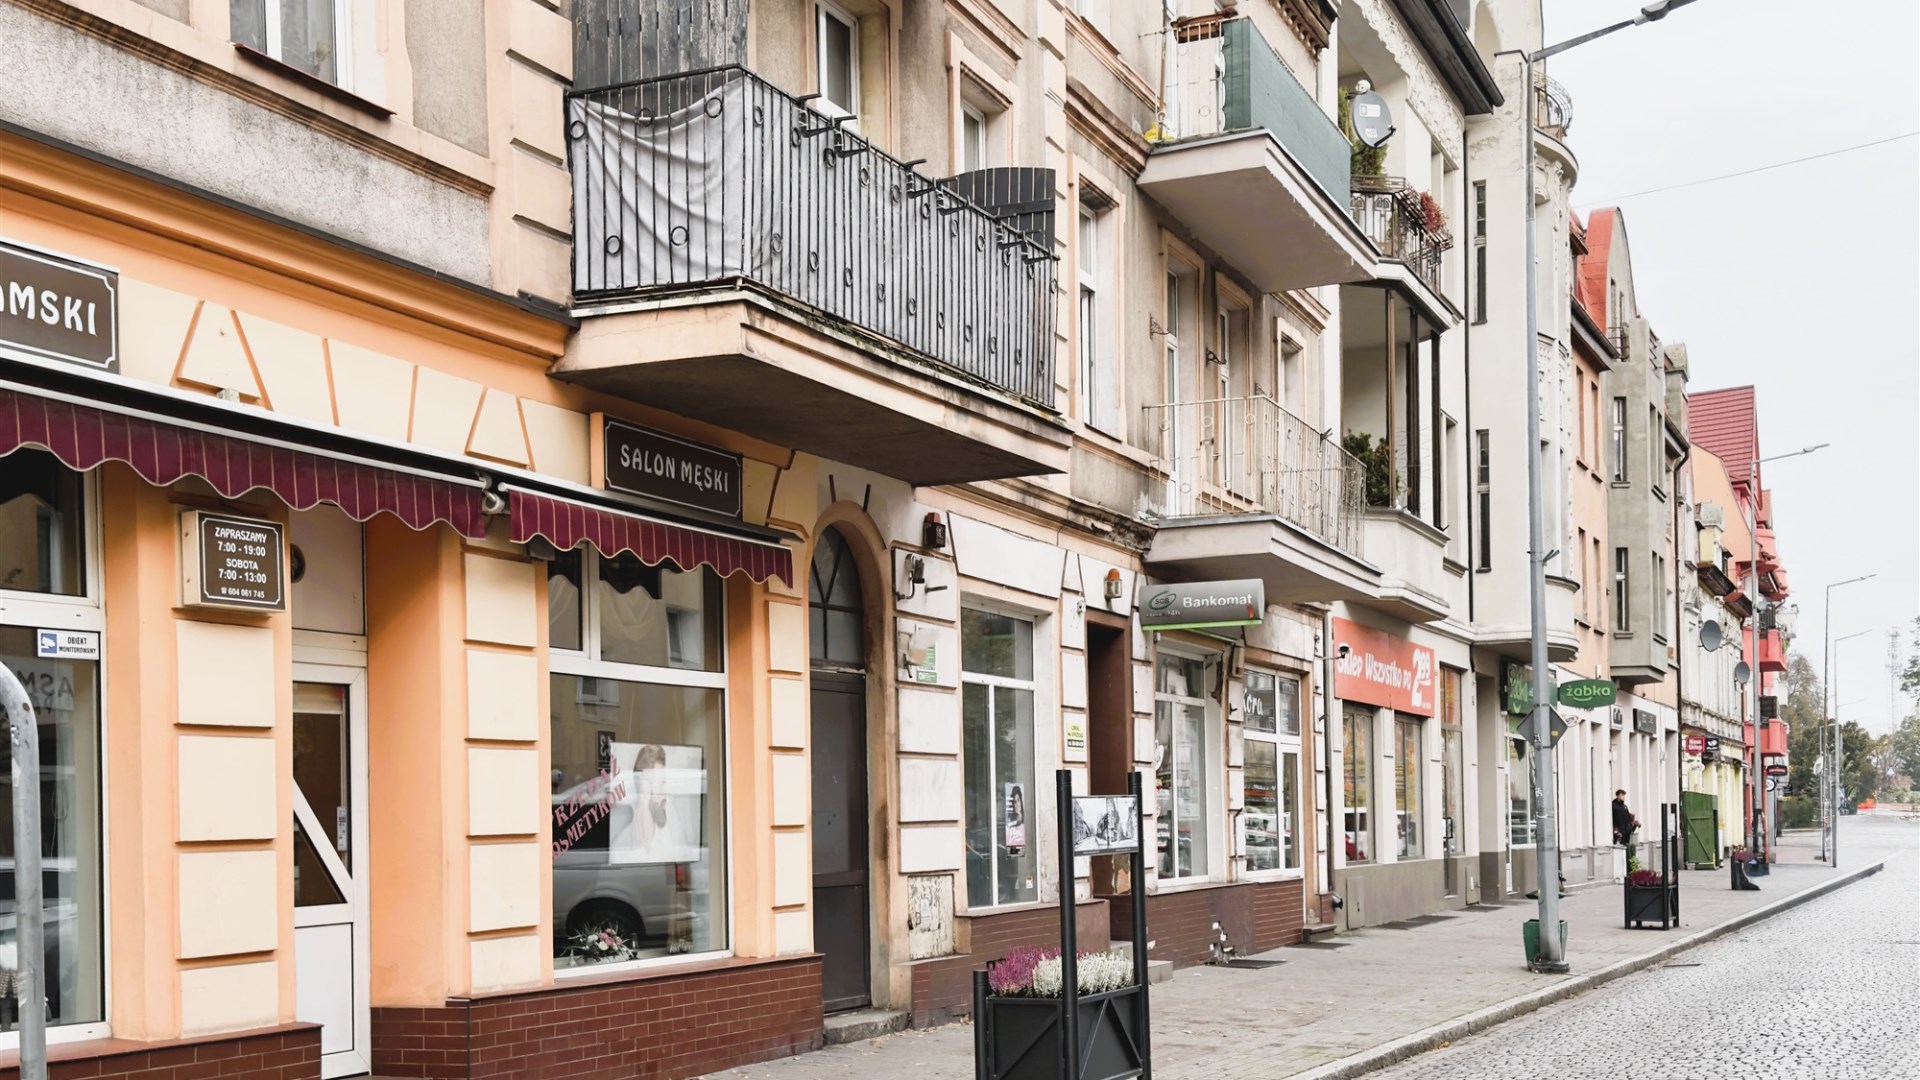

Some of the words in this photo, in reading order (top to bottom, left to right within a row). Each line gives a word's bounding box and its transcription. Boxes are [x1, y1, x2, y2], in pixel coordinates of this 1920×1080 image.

[0, 281, 97, 336] MSKI
[621, 444, 675, 479] SALON
[681, 460, 728, 493] MĘSKI
[215, 527, 267, 543] ZAPRASZAMY
[218, 541, 236, 553] 7:00
[244, 544, 266, 557] 19:00
[226, 558, 258, 570] SOBOTA
[219, 568, 237, 580] 7:00
[245, 572, 267, 584] 13:00
[228, 588, 240, 596] 604
[253, 590, 265, 598] 745
[1183, 594, 1252, 607] Bankomat
[67, 636, 87, 645] OBIEKT
[59, 646, 96, 654] MONITOROWANY
[1365, 653, 1402, 688] Wszystko
[1566, 685, 1610, 697] żabka
[551, 754, 621, 827] RZEDAŻ
